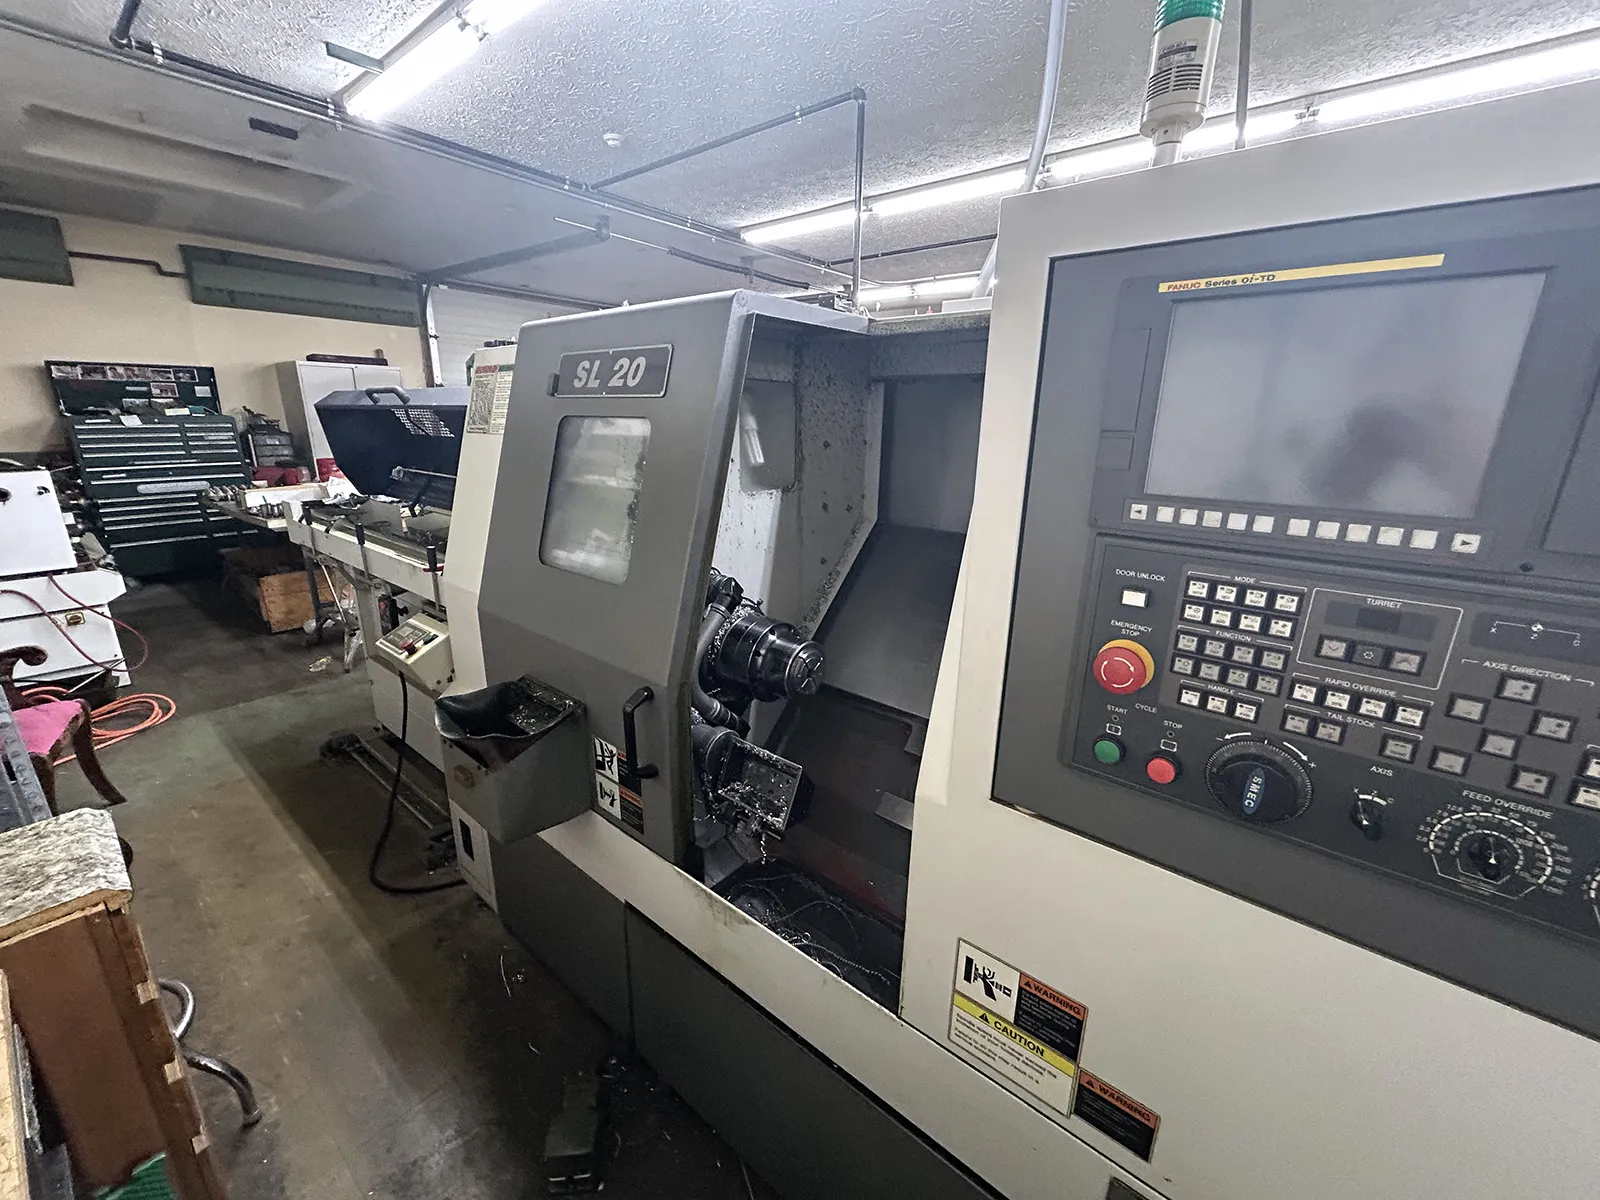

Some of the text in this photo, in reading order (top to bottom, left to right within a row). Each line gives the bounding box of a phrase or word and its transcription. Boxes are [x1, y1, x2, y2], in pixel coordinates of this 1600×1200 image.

[1167, 282, 1201, 291] FANUC
[1204, 280, 1238, 288] Series
[573, 355, 647, 389] SL 20
[1115, 568, 1166, 582] DOOR UNLOCK
[1234, 575, 1257, 584] MODE
[1366, 597, 1403, 609] TURRET
[1110, 619, 1153, 633] EMERGENCY
[1121, 628, 1140, 637] STOP
[1215, 630, 1252, 643] FUNCTION
[1482, 660, 1573, 682] AXIS DIRECTION
[1207, 684, 1236, 696] HANDLE
[1324, 676, 1397, 698] RAPID OVERRIDE
[1106, 704, 1128, 715] START
[1134, 702, 1158, 714] CYCLE
[1163, 719, 1183, 730] STOP
[1326, 710, 1376, 729] TAIL STOCK
[1370, 765, 1394, 777] AXIS
[1244, 775, 1263, 808] SMEC
[1462, 789, 1492, 803] FEED
[1494, 798, 1553, 820] OVERRIDE
[1033, 984, 1082, 1016] WARNING
[993, 1020, 1046, 1057] CAUTION
[1098, 1084, 1152, 1122] WARNING
